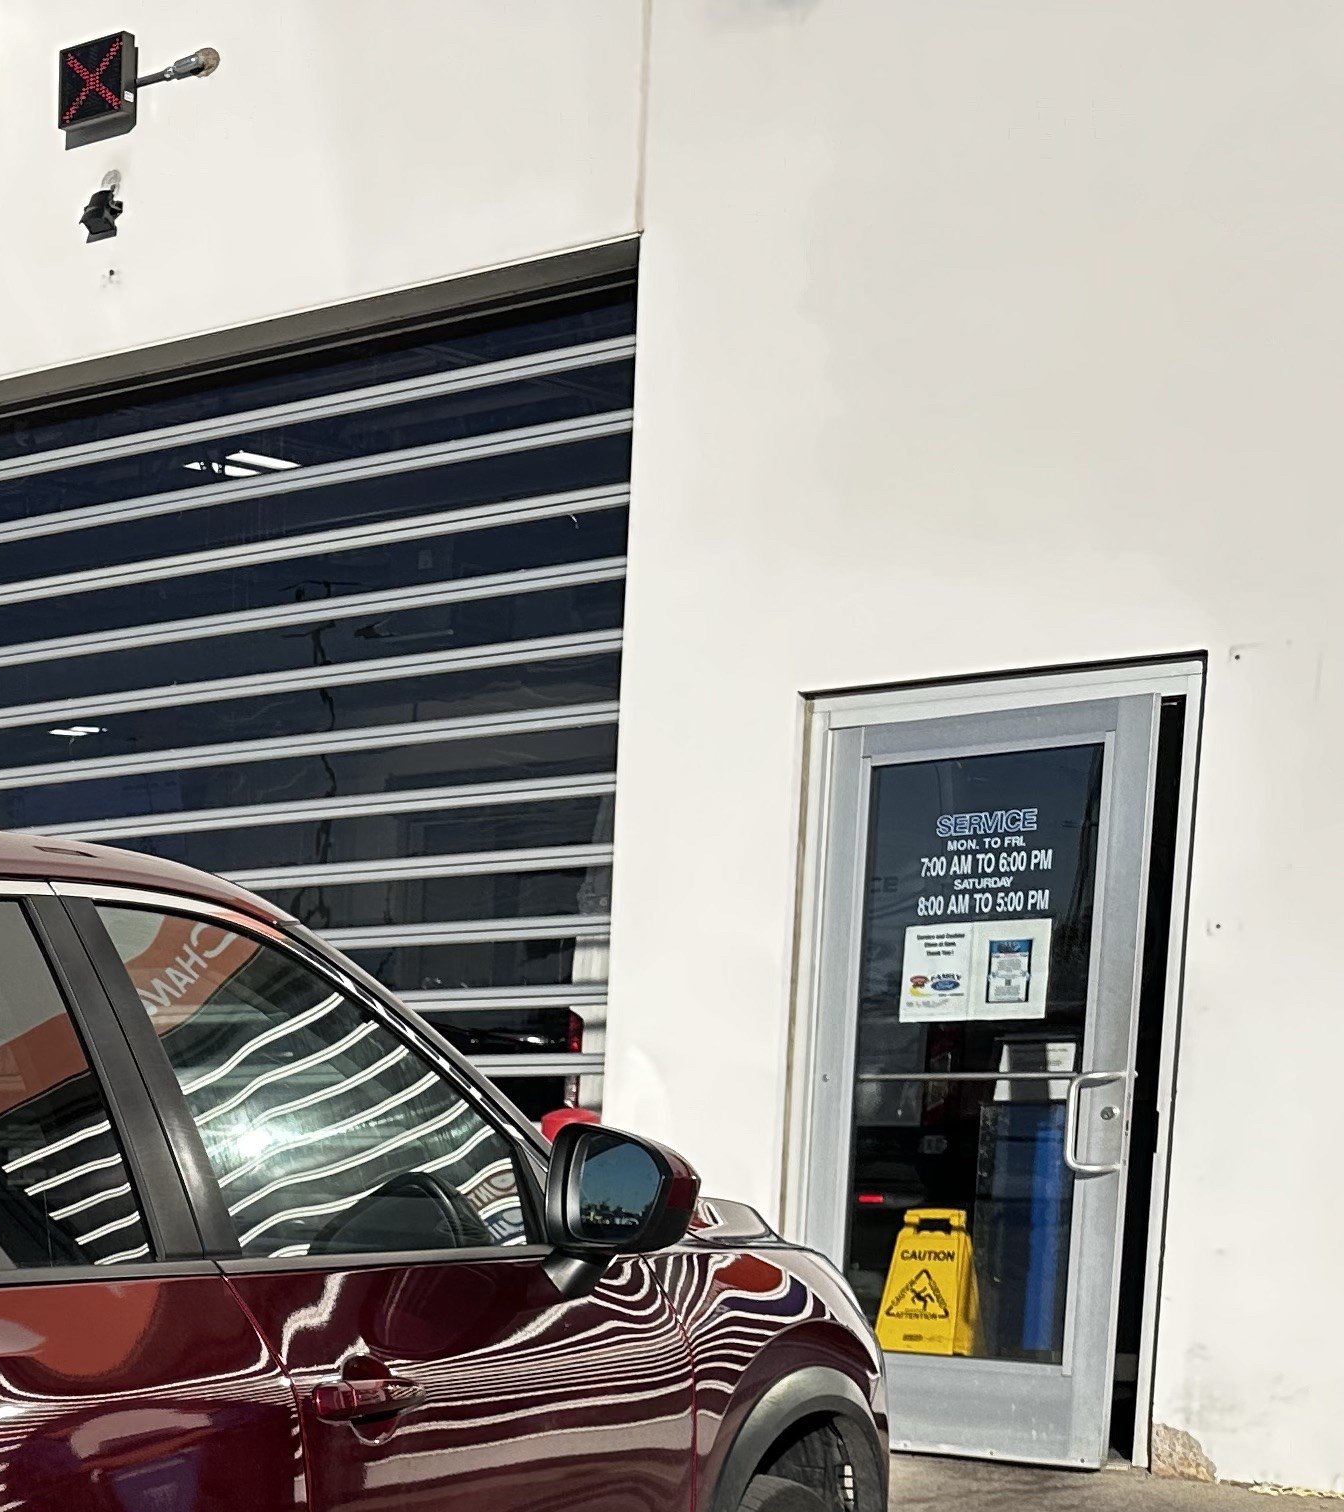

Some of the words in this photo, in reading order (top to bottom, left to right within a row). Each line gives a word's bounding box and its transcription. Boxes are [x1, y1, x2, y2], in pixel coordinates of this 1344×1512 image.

[935, 808, 1038, 837] SERVICE
[947, 839, 979, 851] MON.
[983, 837, 1001, 849] TO
[920, 856, 947, 877] 7:00
[949, 854, 972, 876] AM
[976, 853, 995, 874] TO
[998, 851, 1027, 873] 6:00
[1030, 849, 1053, 871] PM
[953, 876, 1013, 890] SATURDAY
[917, 895, 944, 917] 8:00
[947, 894, 969, 915] AM
[973, 892, 993, 913] TO
[995, 891, 1024, 912] 5:00
[1027, 889, 1050, 911] PM
[900, 1249, 956, 1262] CAUTION
